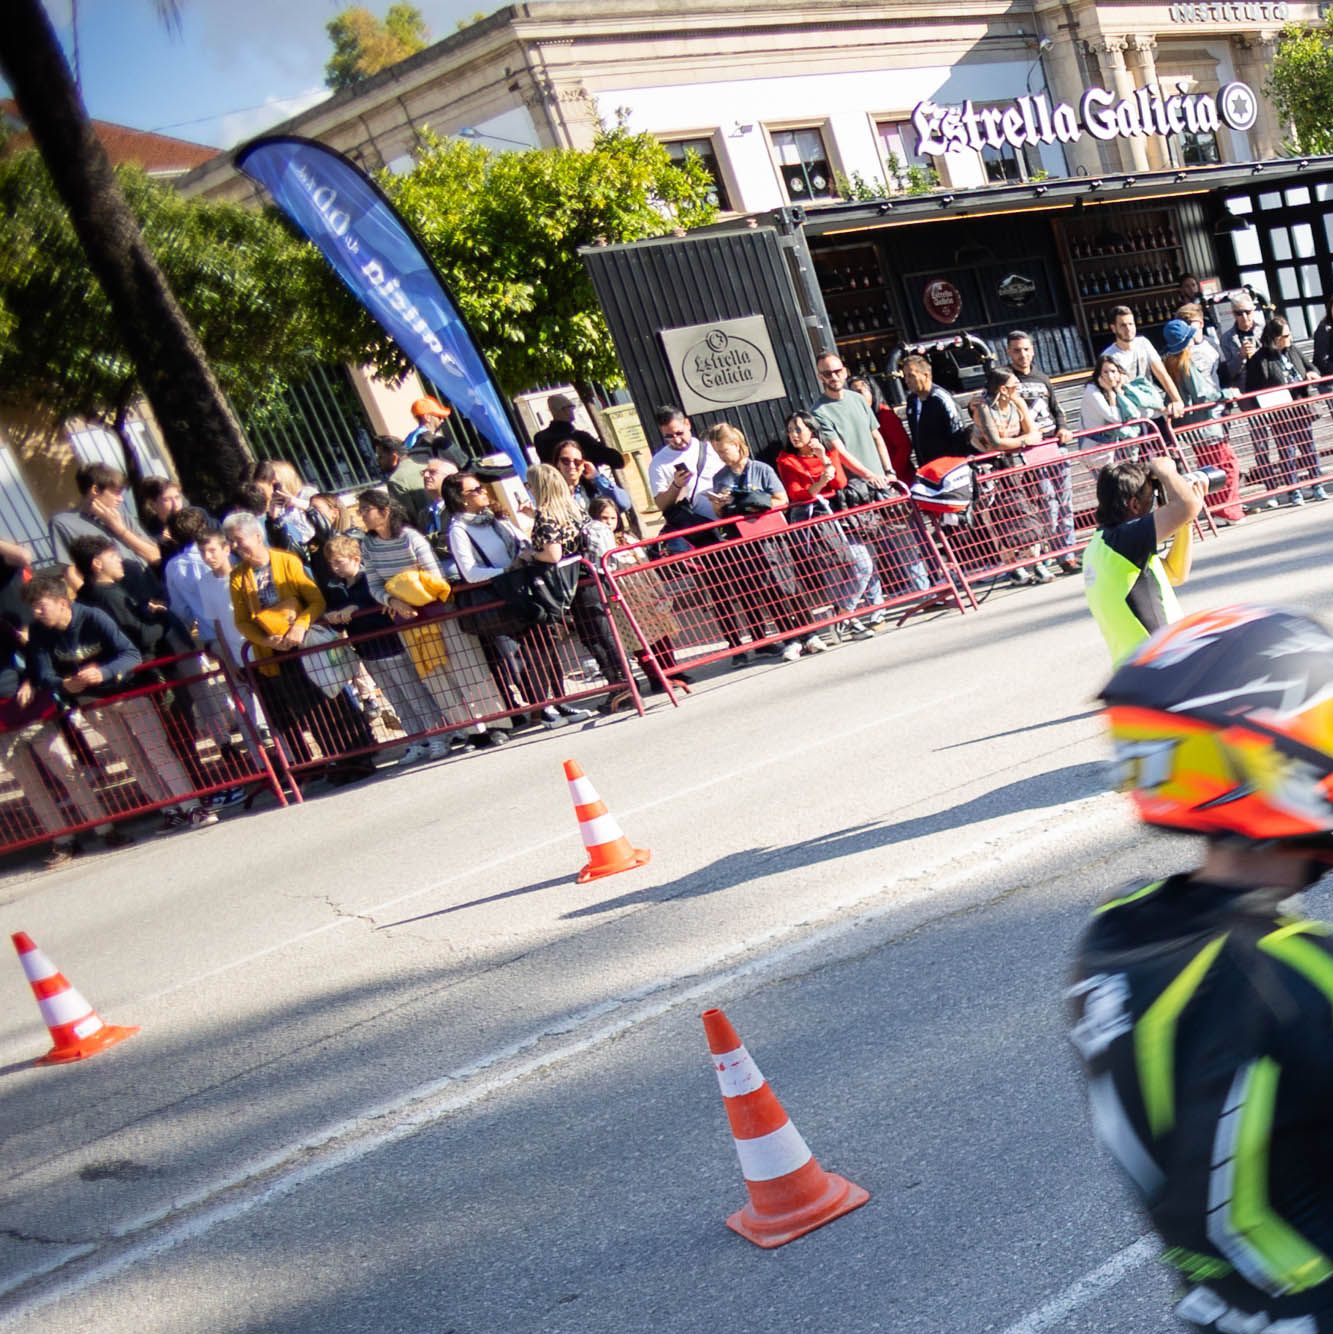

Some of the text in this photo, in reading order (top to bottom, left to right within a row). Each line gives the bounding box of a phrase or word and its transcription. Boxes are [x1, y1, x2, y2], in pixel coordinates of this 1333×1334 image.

[1169, 2, 1289, 23] INSTITUTO
[912, 82, 1222, 157] Estrella Galicia
[694, 350, 751, 373] Estrella
[701, 366, 753, 388] Galicia
